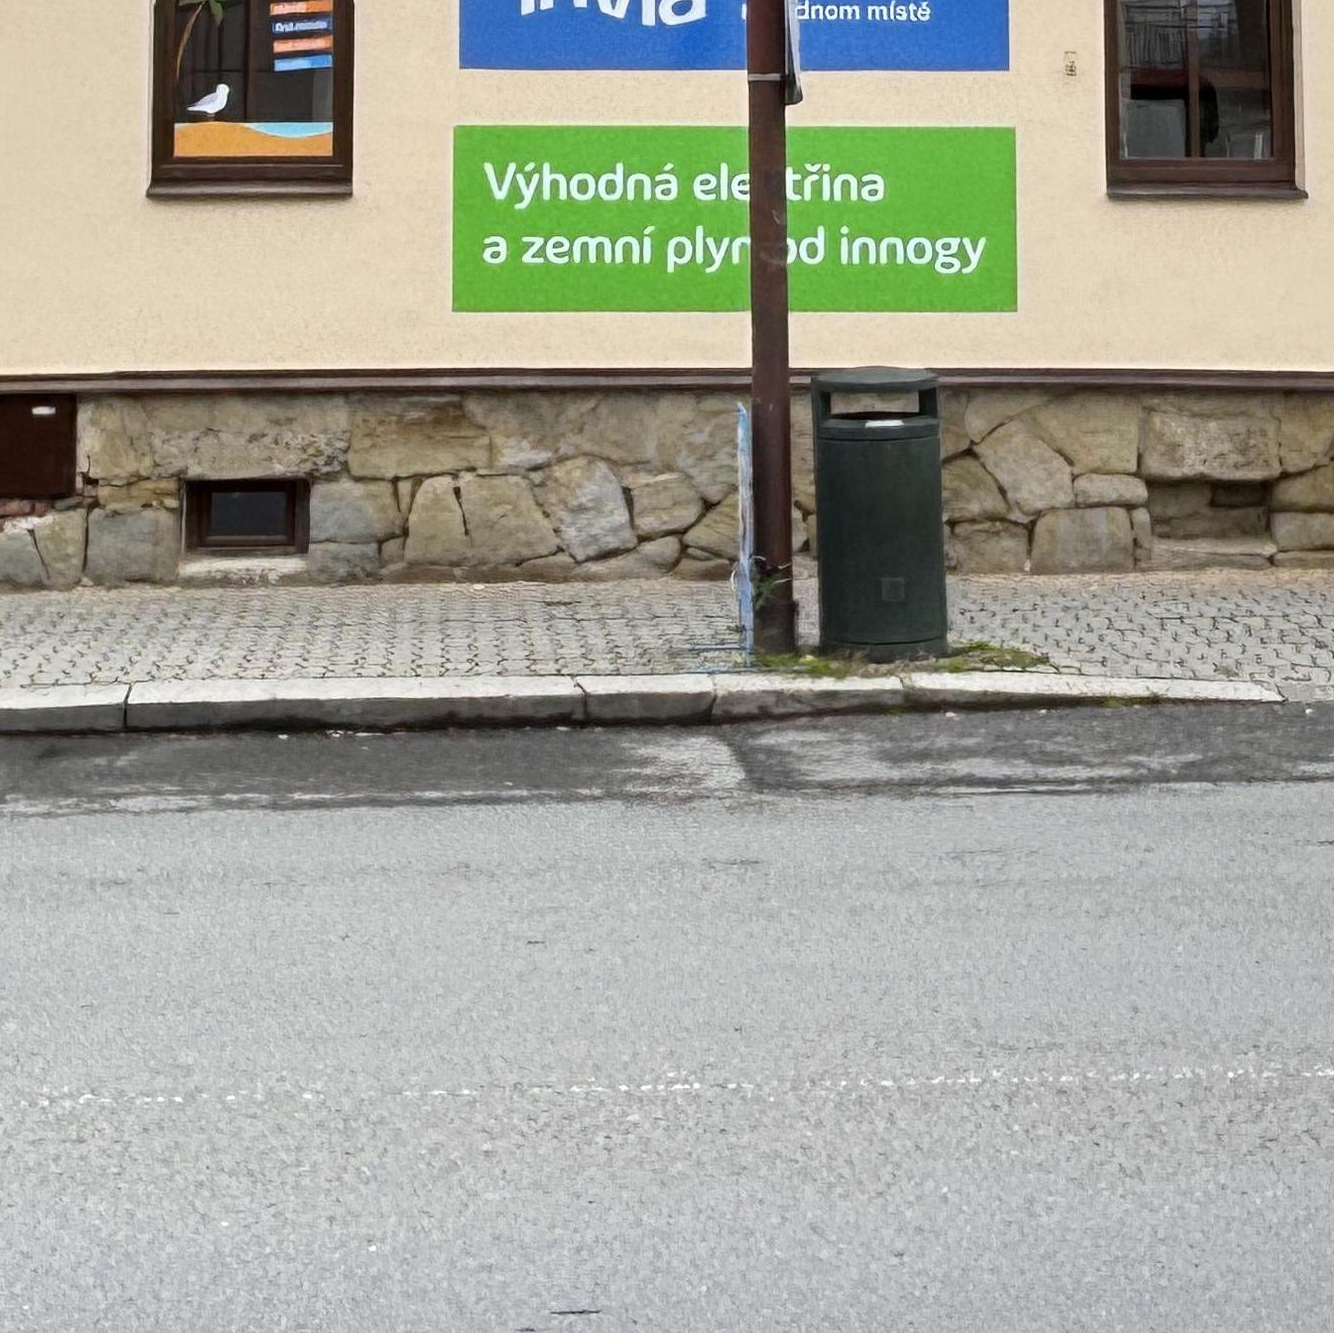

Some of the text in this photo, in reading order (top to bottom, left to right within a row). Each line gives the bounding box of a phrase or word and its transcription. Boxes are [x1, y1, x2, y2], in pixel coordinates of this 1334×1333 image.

[867, 0, 932, 21] místě
[483, 162, 886, 210] Výhodná eletřina
[482, 235, 508, 264] a
[521, 225, 655, 264] zemní
[839, 225, 987, 274] innogy
